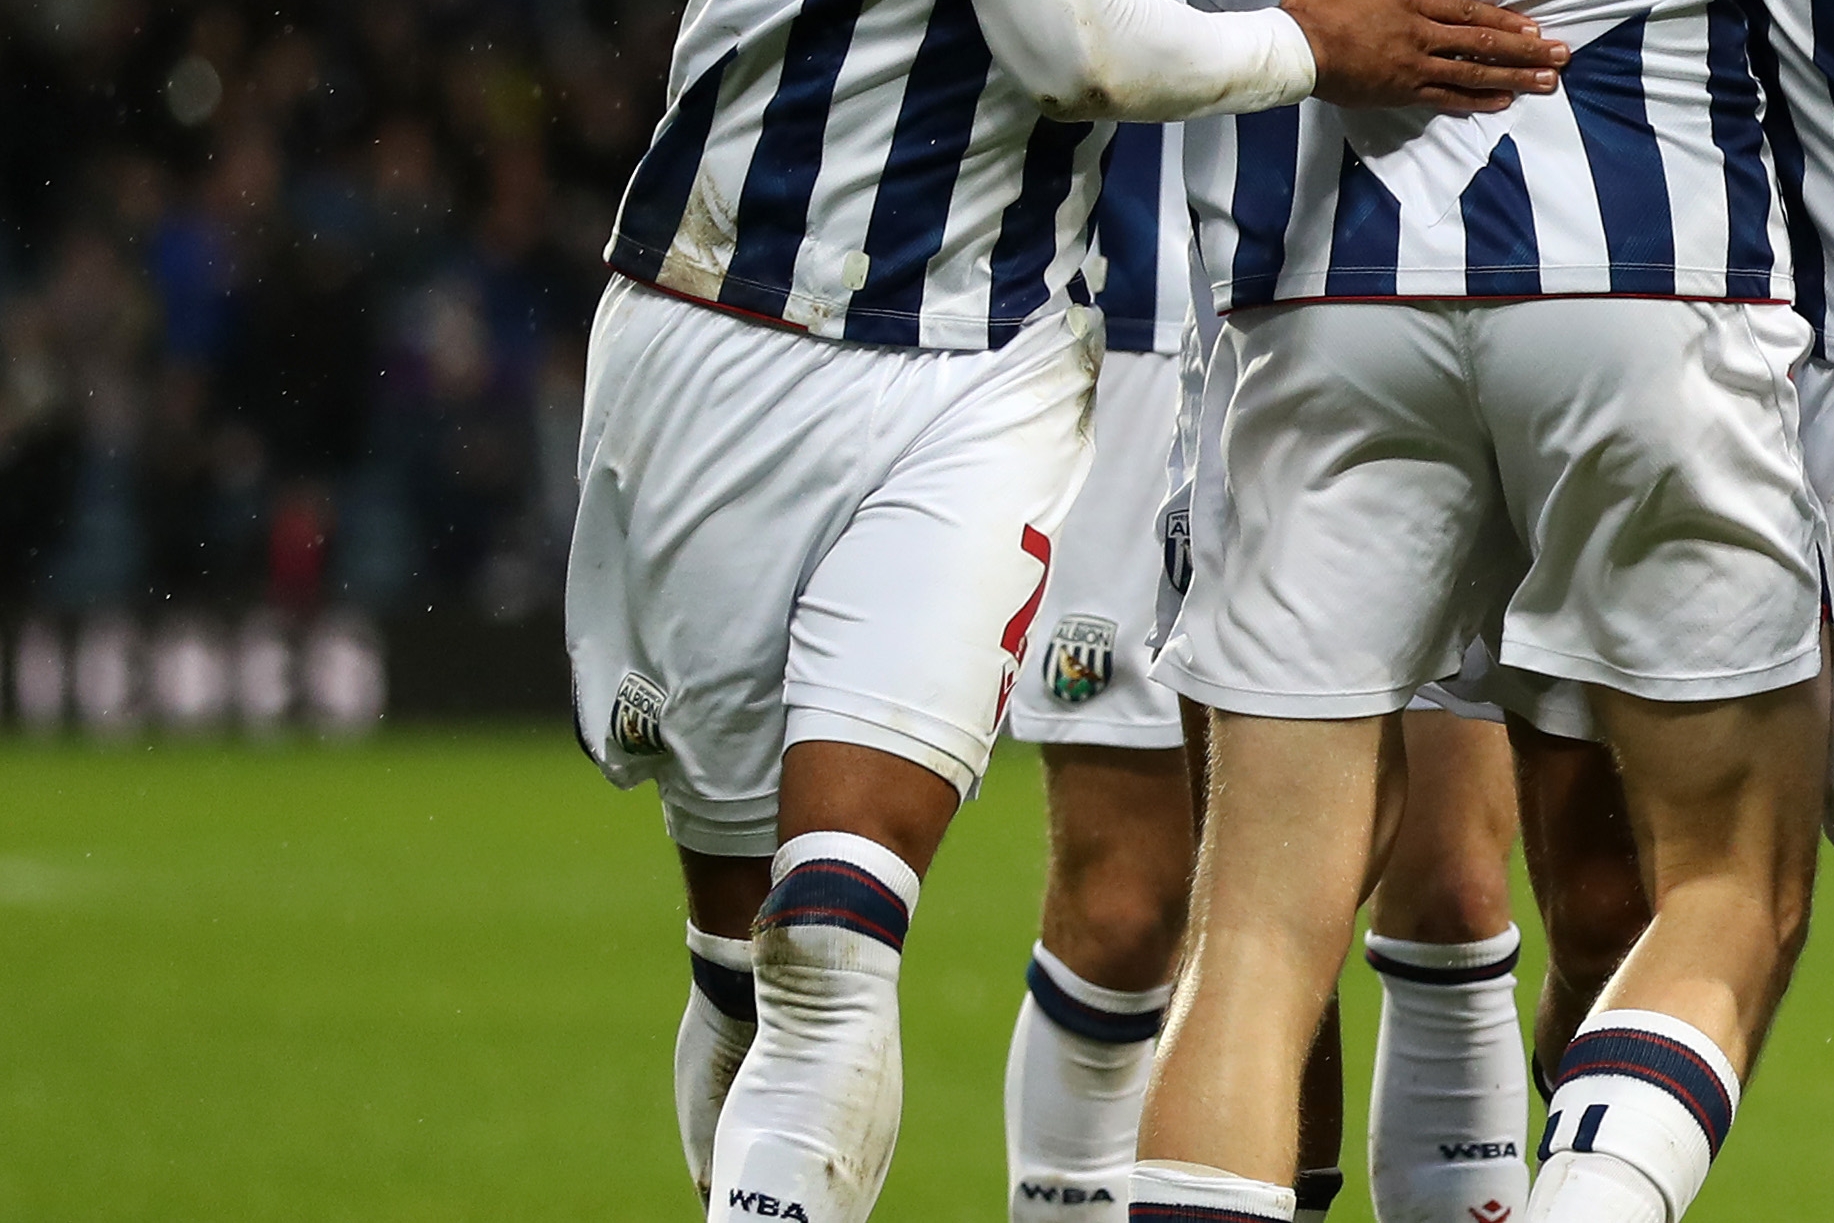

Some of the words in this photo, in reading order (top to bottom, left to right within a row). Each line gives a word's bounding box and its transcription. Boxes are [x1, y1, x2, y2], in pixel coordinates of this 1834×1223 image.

[1438, 1142, 1517, 1161] WBA
[1021, 1181, 1115, 1204] WBA
[729, 1188, 809, 1223] WBA
